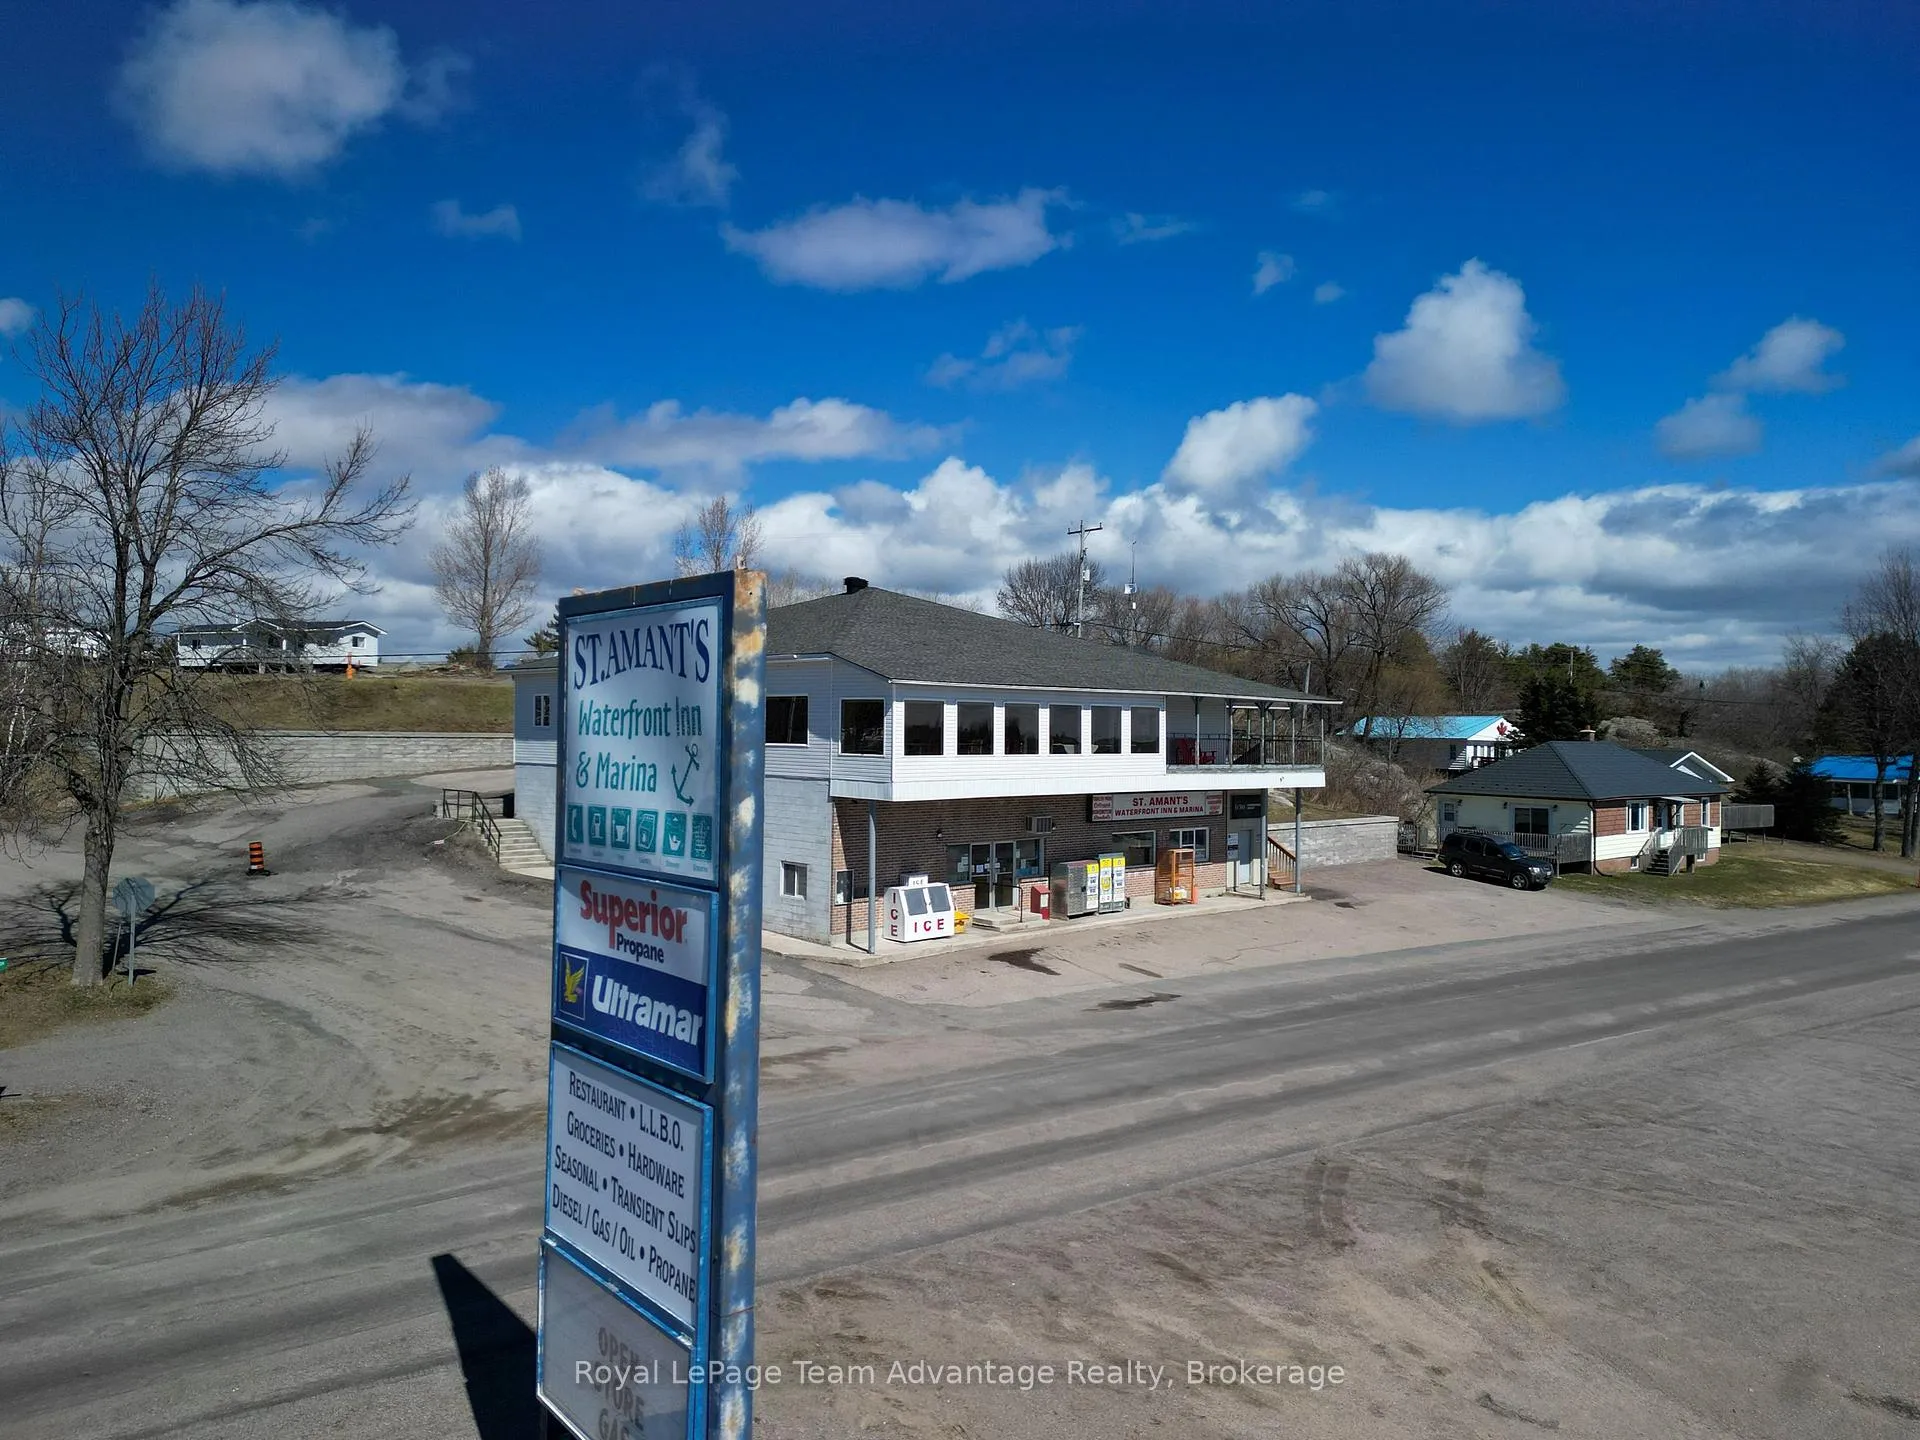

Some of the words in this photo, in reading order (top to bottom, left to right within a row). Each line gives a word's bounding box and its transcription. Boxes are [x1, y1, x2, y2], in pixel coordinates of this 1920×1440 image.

[578, 699, 672, 740] Waterfront
[675, 696, 703, 737] Inn
[575, 751, 591, 788] &
[595, 752, 657, 792] Marina
[1114, 808, 1160, 817] WATERFRONT
[1179, 806, 1204, 814] MARINA
[1132, 797, 1146, 807] ST.
[1149, 796, 1189, 806] AMANT'S
[580, 880, 688, 949] Superior
[890, 892, 898, 937] ICE
[913, 918, 945, 933] ICE
[616, 933, 665, 964] Propane
[591, 975, 703, 1046] Ultramar
[569, 1070, 626, 1122] RESTAURANT
[567, 1111, 616, 1159] GROCERIES
[628, 1142, 685, 1199] HARDWARE
[554, 1145, 599, 1192] SEASONAL
[611, 1176, 665, 1233] TRANSIENT
[667, 1210, 696, 1254] SLIPS
[648, 1245, 696, 1304] PROPANE
